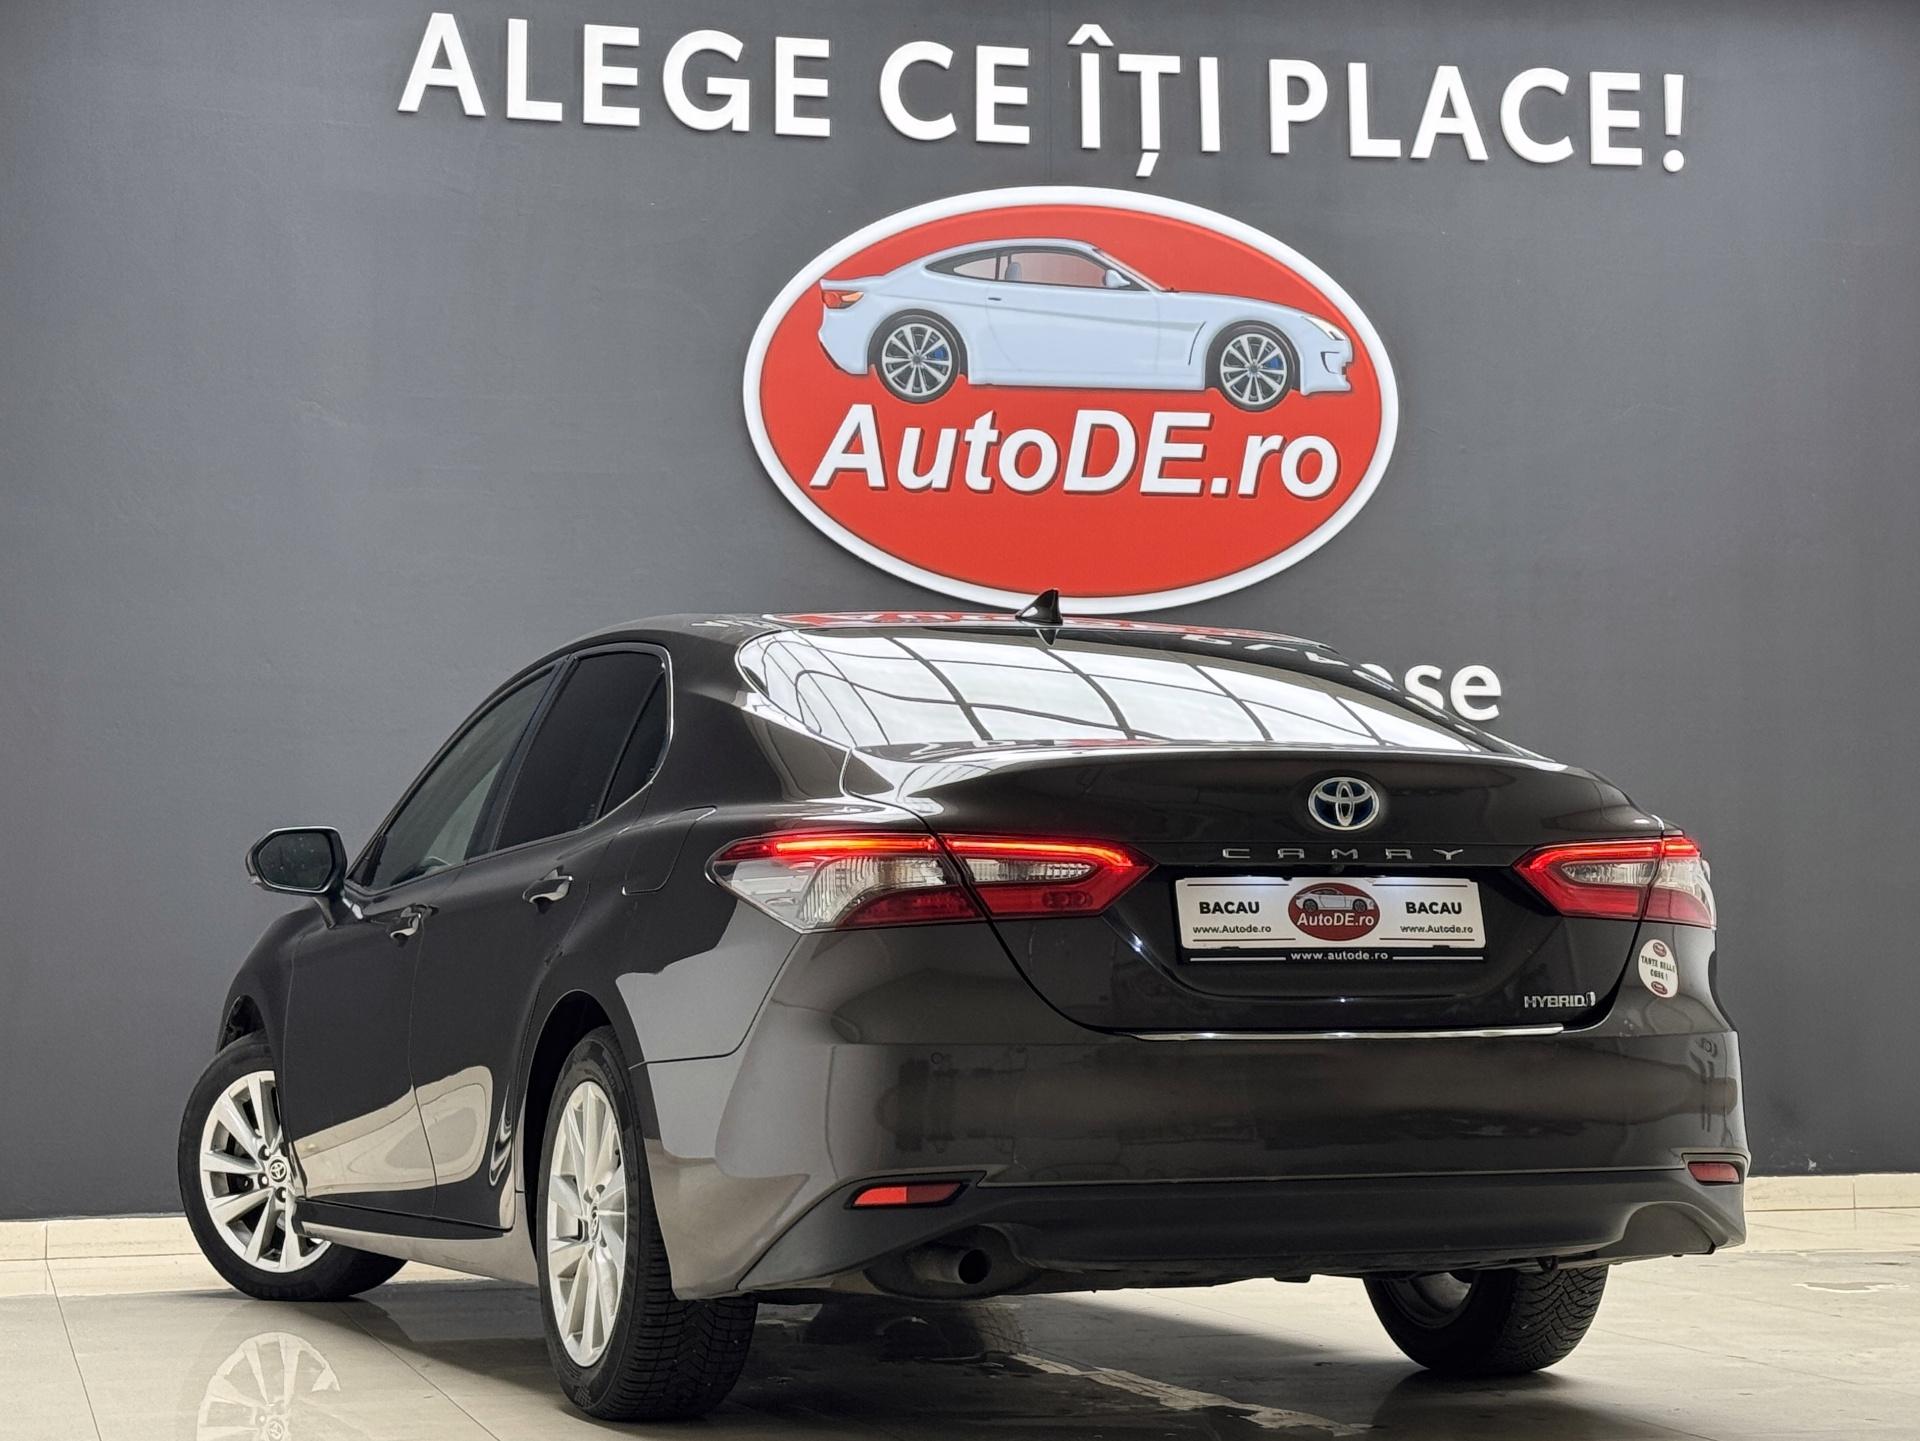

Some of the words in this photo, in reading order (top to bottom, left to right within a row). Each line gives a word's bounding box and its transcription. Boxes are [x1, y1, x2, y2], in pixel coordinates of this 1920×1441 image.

[398, 12, 831, 138] ALEGE
[879, 40, 1031, 145] CE
[1269, 58, 1686, 173] PLACE!
[810, 403, 1339, 499] AutoDE.ro
[1222, 848, 1464, 861] CAMRY
[1199, 901, 1260, 915] BACAU
[1405, 901, 1463, 915] BACAU
[1297, 911, 1375, 928] AutoDE.ro
[1192, 925, 1272, 935] www.Autode.ro
[1399, 925, 1474, 935] www.Autode.ro
[1290, 951, 1389, 962] www.autode.ro
[1524, 995, 1585, 1009] HYBRID
